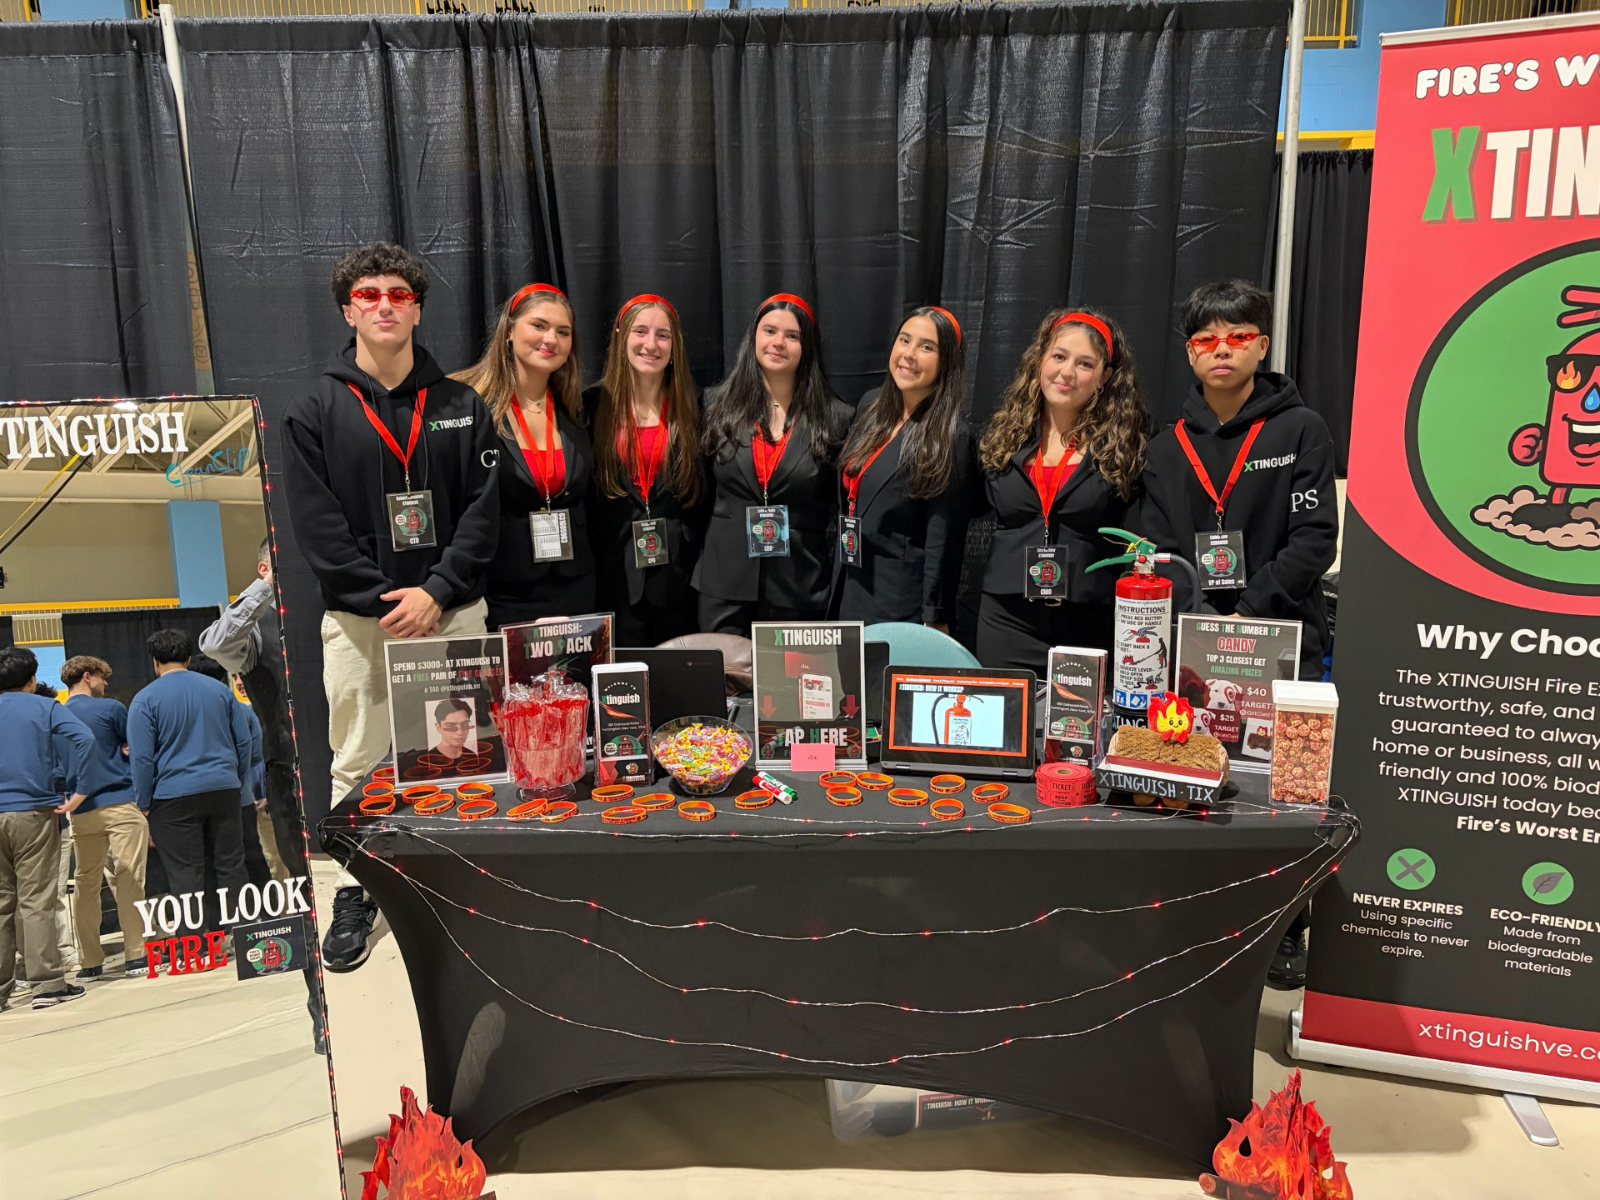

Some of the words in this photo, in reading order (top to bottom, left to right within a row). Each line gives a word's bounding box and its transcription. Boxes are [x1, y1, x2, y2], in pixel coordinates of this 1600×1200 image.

[1415, 59, 1540, 99] FIRE'S
[1554, 53, 1600, 87] W
[429, 416, 474, 431] XTINGUIS
[0, 412, 189, 460] TINGUISH
[1291, 489, 1319, 513] PS
[1118, 605, 1166, 614] INSTRUCTIONS
[533, 622, 582, 638] XTINGUISH:
[774, 629, 842, 646] XTINGUISH
[1196, 622, 1219, 633] GUESS
[1222, 624, 1235, 634] THE
[1237, 625, 1268, 636] NUMBER
[1270, 627, 1280, 637] OF
[523, 640, 553, 659] TWO
[555, 636, 593, 656] PACK
[1217, 637, 1257, 653] CANDY
[1417, 623, 1503, 660] Why
[393, 662, 416, 672] SPEND
[445, 659, 455, 668] AT
[456, 657, 490, 667] XTINGUISH
[492, 656, 501, 665] TO
[1206, 654, 1218, 662] TOP
[1226, 656, 1253, 666] CLOSEST
[1254, 658, 1266, 666] GET
[392, 674, 405, 684] GET
[406, 675, 412, 683] A
[413, 673, 430, 682] FREE
[431, 671, 447, 681] PAIR
[448, 671, 457, 680] OF
[1053, 673, 1092, 687] Xtinguish
[1210, 665, 1239, 675] AMAZING
[1241, 668, 1262, 677] PRIZES
[429, 685, 440, 693] TAG
[1247, 686, 1267, 697] $40
[1396, 669, 1432, 685] The
[1436, 672, 1540, 692] XTINGUISH
[1545, 678, 1582, 695] Fire
[1588, 681, 1600, 697] E
[602, 693, 640, 705] Xtinguish
[1240, 701, 1271, 709] TARGET
[1378, 691, 1495, 718] trustworthy,
[1499, 700, 1548, 720] safe,
[1553, 706, 1596, 721] and
[1220, 714, 1235, 722] $25
[776, 728, 805, 747] TAP
[810, 728, 848, 746] HERE
[1214, 724, 1239, 732] TARGET
[1391, 718, 1510, 739] guaranteed
[1515, 725, 1535, 740] to
[1372, 737, 1430, 756] home
[1434, 744, 1455, 758] or
[1460, 745, 1552, 768] business,
[1557, 753, 1582, 769] all
[1378, 761, 1451, 786] friendly
[1456, 770, 1496, 785] and
[1501, 771, 1548, 790] 100%
[1052, 782, 1071, 791] TICKET
[1099, 772, 1176, 798] XTINGUISH
[1186, 785, 1215, 804] TIX
[1397, 787, 1497, 809] XTINGUISH
[1502, 796, 1562, 818] today
[1456, 815, 1511, 833] Fire's
[1515, 820, 1578, 841] Worst
[133, 891, 205, 938] YOU
[216, 876, 311, 925] LOOK
[1352, 892, 1401, 909] NEVER
[1403, 899, 1464, 916] EXPIRES
[1360, 909, 1397, 926] Using
[1400, 915, 1453, 930] specific
[246, 925, 292, 941] XTINGUISH
[1341, 922, 1411, 940] chemicals
[1414, 932, 1428, 943] to
[1431, 935, 1470, 947] never
[1503, 926, 1543, 940] Made
[1546, 931, 1581, 946] from
[144, 930, 227, 979] FIRE
[1381, 944, 1425, 958] expire.
[1487, 939, 1593, 964] biodegradable
[1504, 959, 1572, 977] materials
[1418, 1022, 1600, 1060] xtinguishve.c
